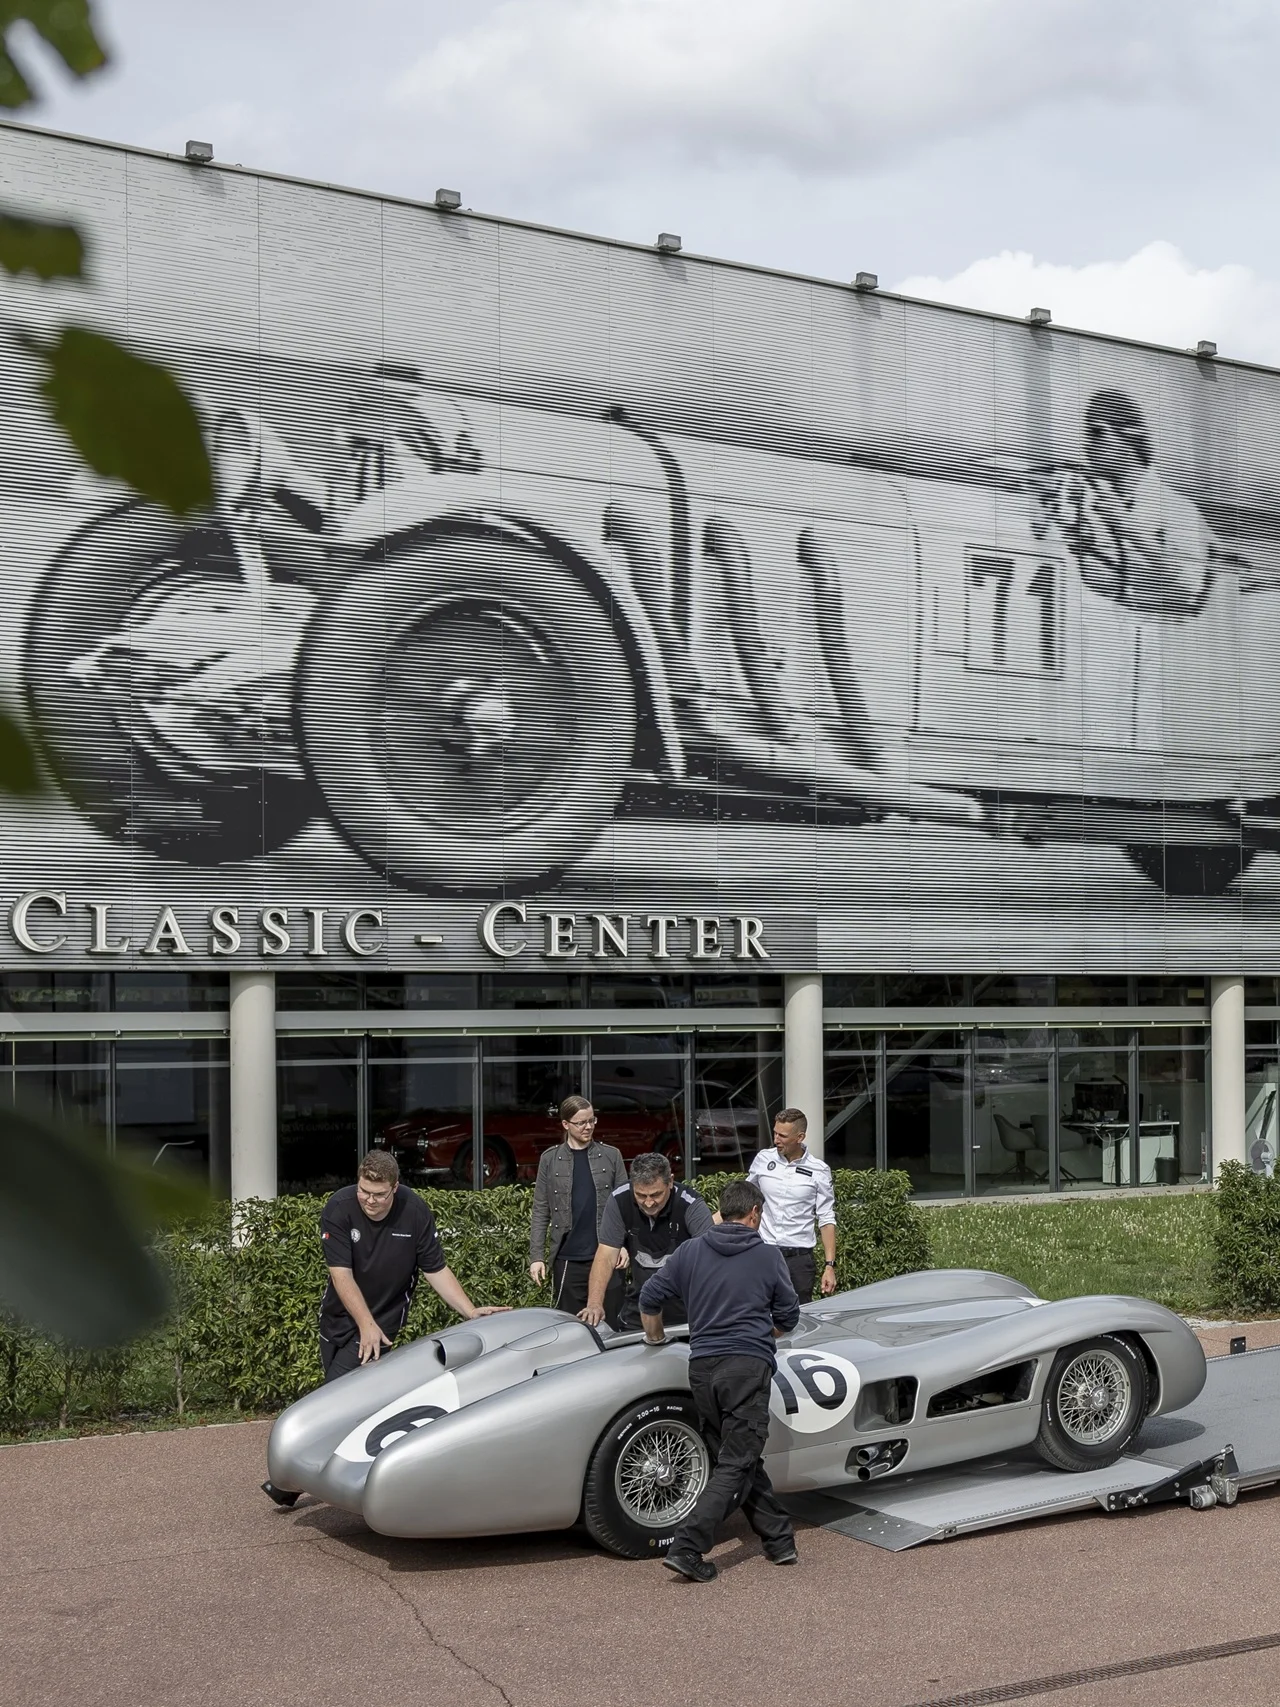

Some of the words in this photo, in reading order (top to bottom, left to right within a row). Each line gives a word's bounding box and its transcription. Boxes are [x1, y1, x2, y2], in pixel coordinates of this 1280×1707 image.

[970, 555, 1057, 670] 71
[8, 889, 386, 956] CLASSIC
[477, 900, 771, 958] CENTER
